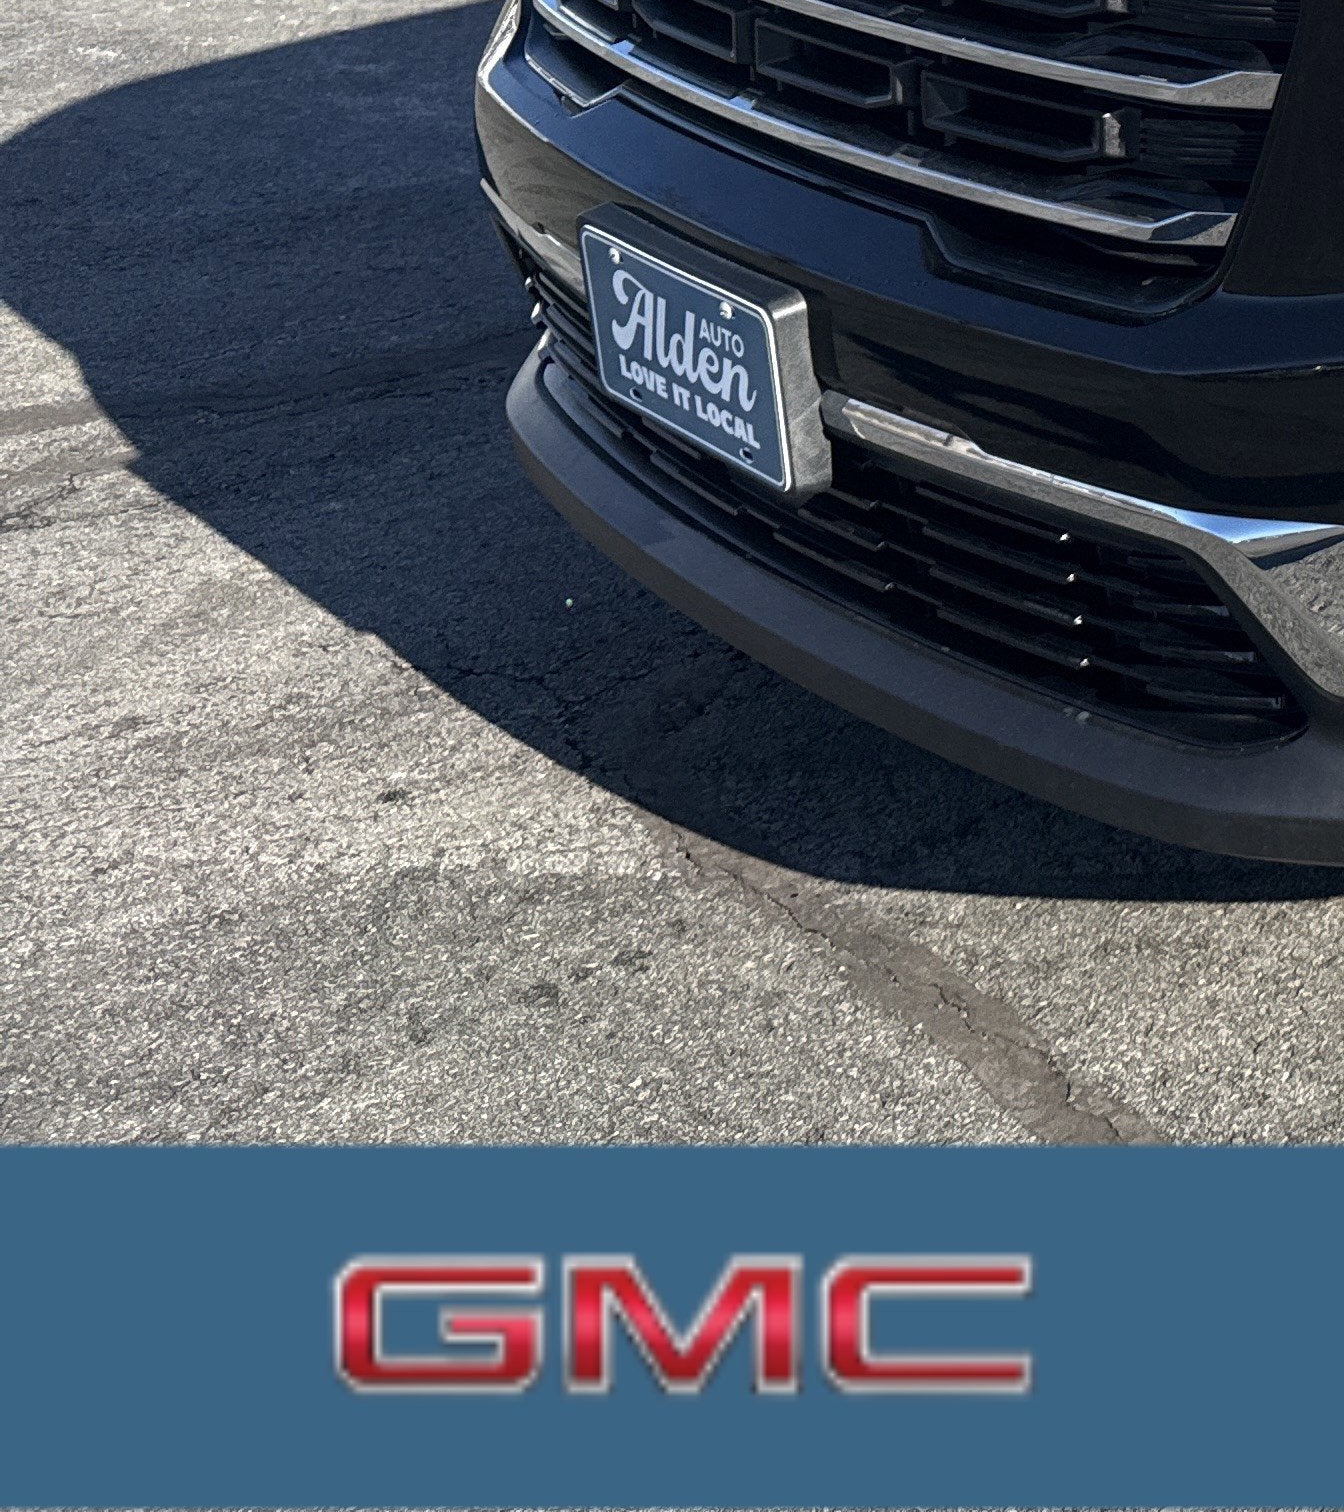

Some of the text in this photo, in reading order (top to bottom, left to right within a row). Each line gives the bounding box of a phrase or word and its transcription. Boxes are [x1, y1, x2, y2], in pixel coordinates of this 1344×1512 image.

[611, 268, 758, 413] Alden
[698, 316, 746, 359] AUTO
[617, 352, 762, 451] LOVE IT LOCAL
